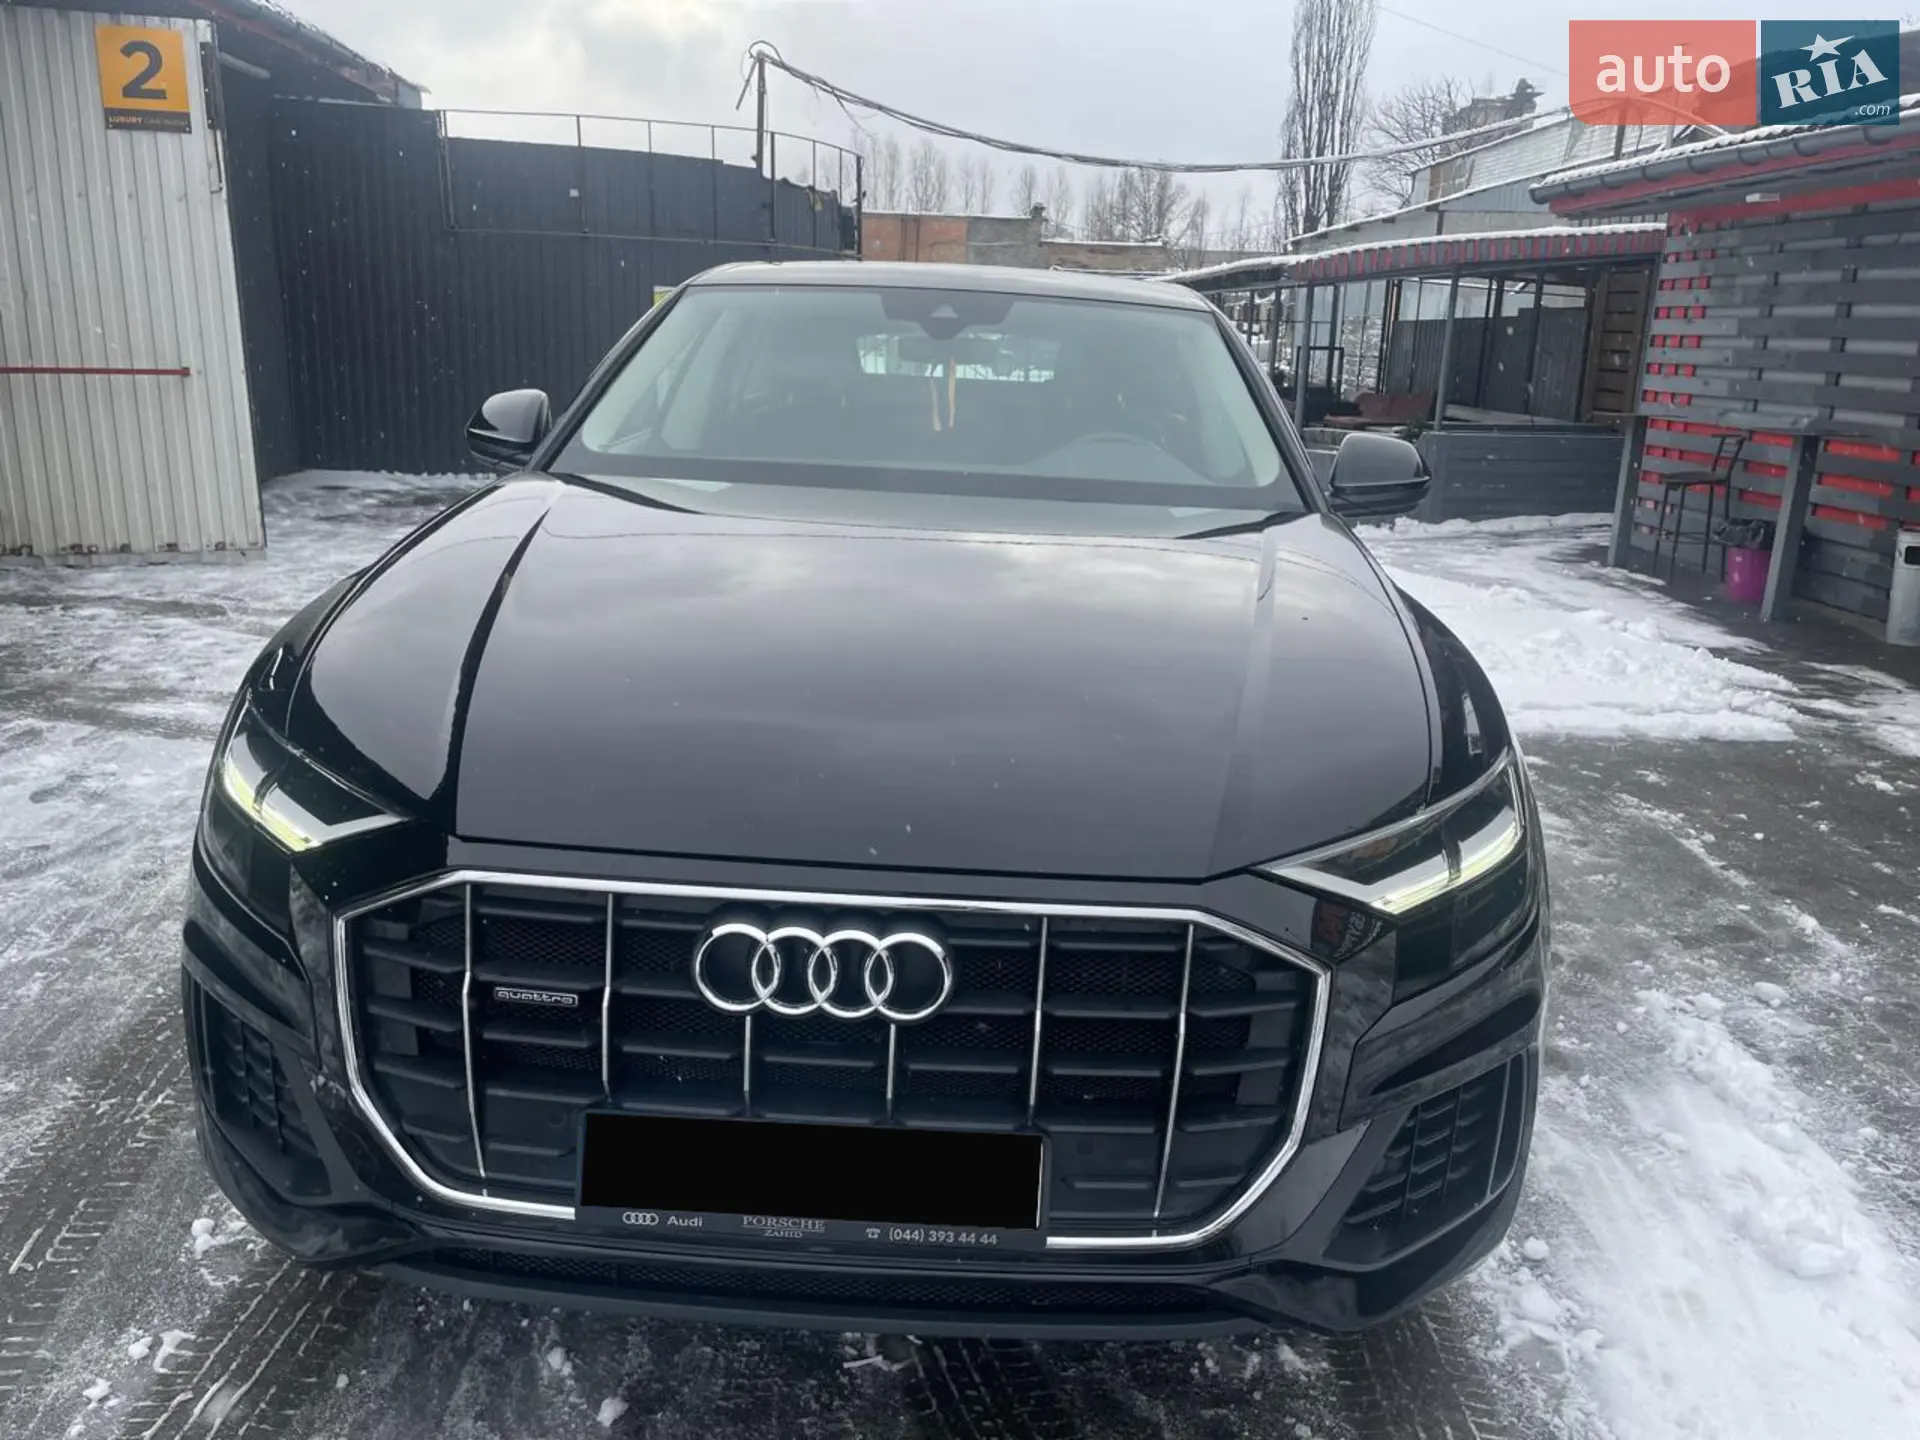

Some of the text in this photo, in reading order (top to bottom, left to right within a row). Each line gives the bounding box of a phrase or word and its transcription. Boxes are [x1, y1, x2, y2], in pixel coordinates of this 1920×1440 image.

[120, 40, 167, 100] 2
[497, 990, 573, 1005] quattro
[666, 1215, 703, 1227] Audi
[743, 1214, 825, 1231] PORSCHE
[889, 1227, 998, 1245] (044) 393 44 44
